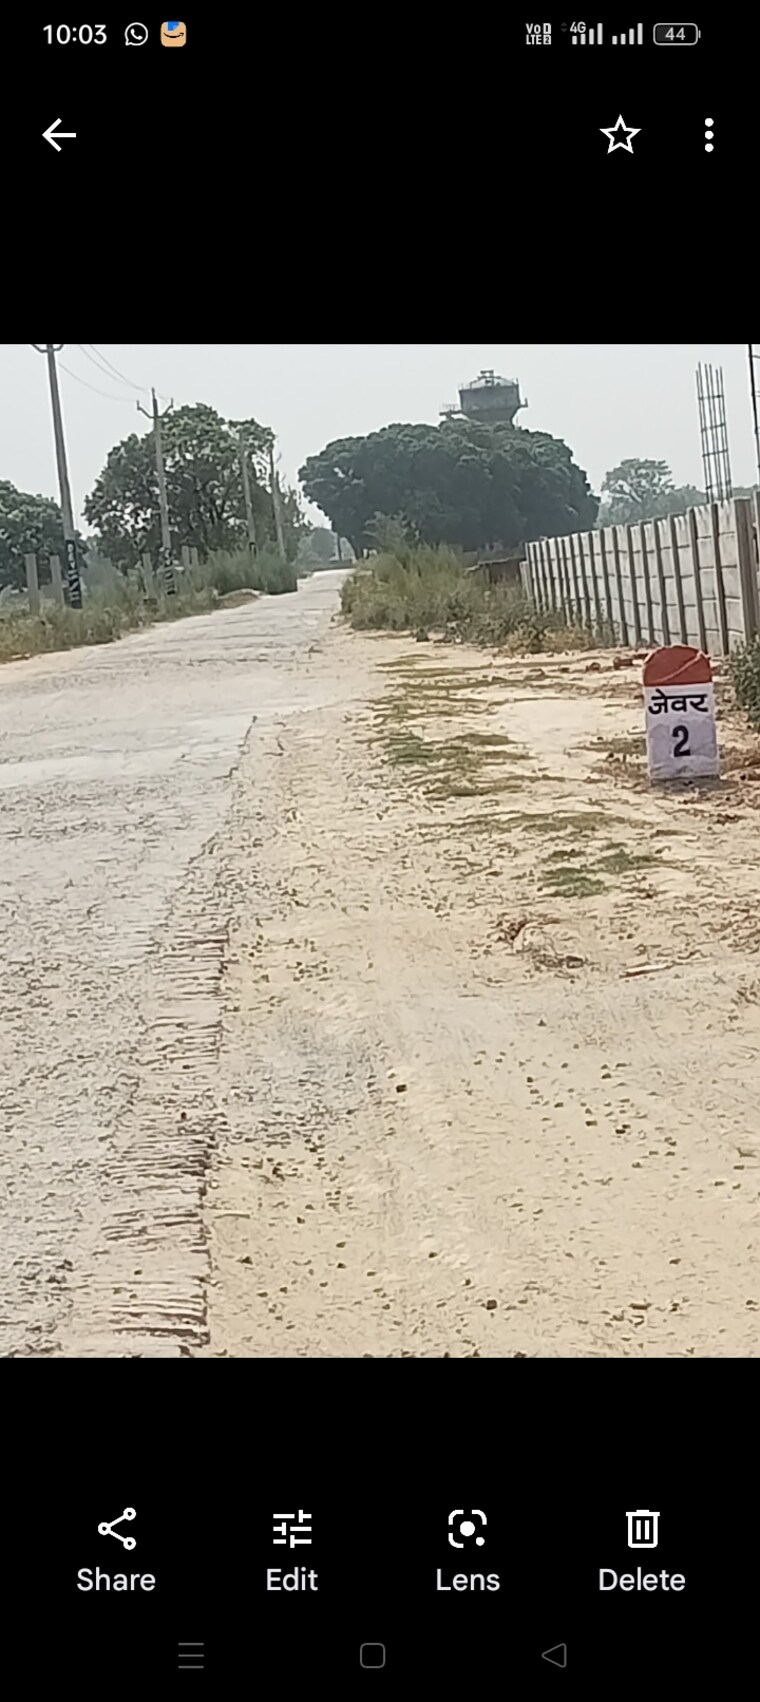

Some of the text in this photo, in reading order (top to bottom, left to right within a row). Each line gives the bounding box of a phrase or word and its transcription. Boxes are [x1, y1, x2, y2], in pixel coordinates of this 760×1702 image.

[42, 23, 108, 45] 10:03
[569, 21, 587, 34] 4G
[664, 26, 686, 41] 44
[648, 688, 709, 715] जेवर
[671, 724, 692, 758] 2
[76, 1566, 156, 1592] Share
[266, 1566, 319, 1592] Edit
[436, 1568, 501, 1592] Lens
[599, 1566, 686, 1592] Delete
